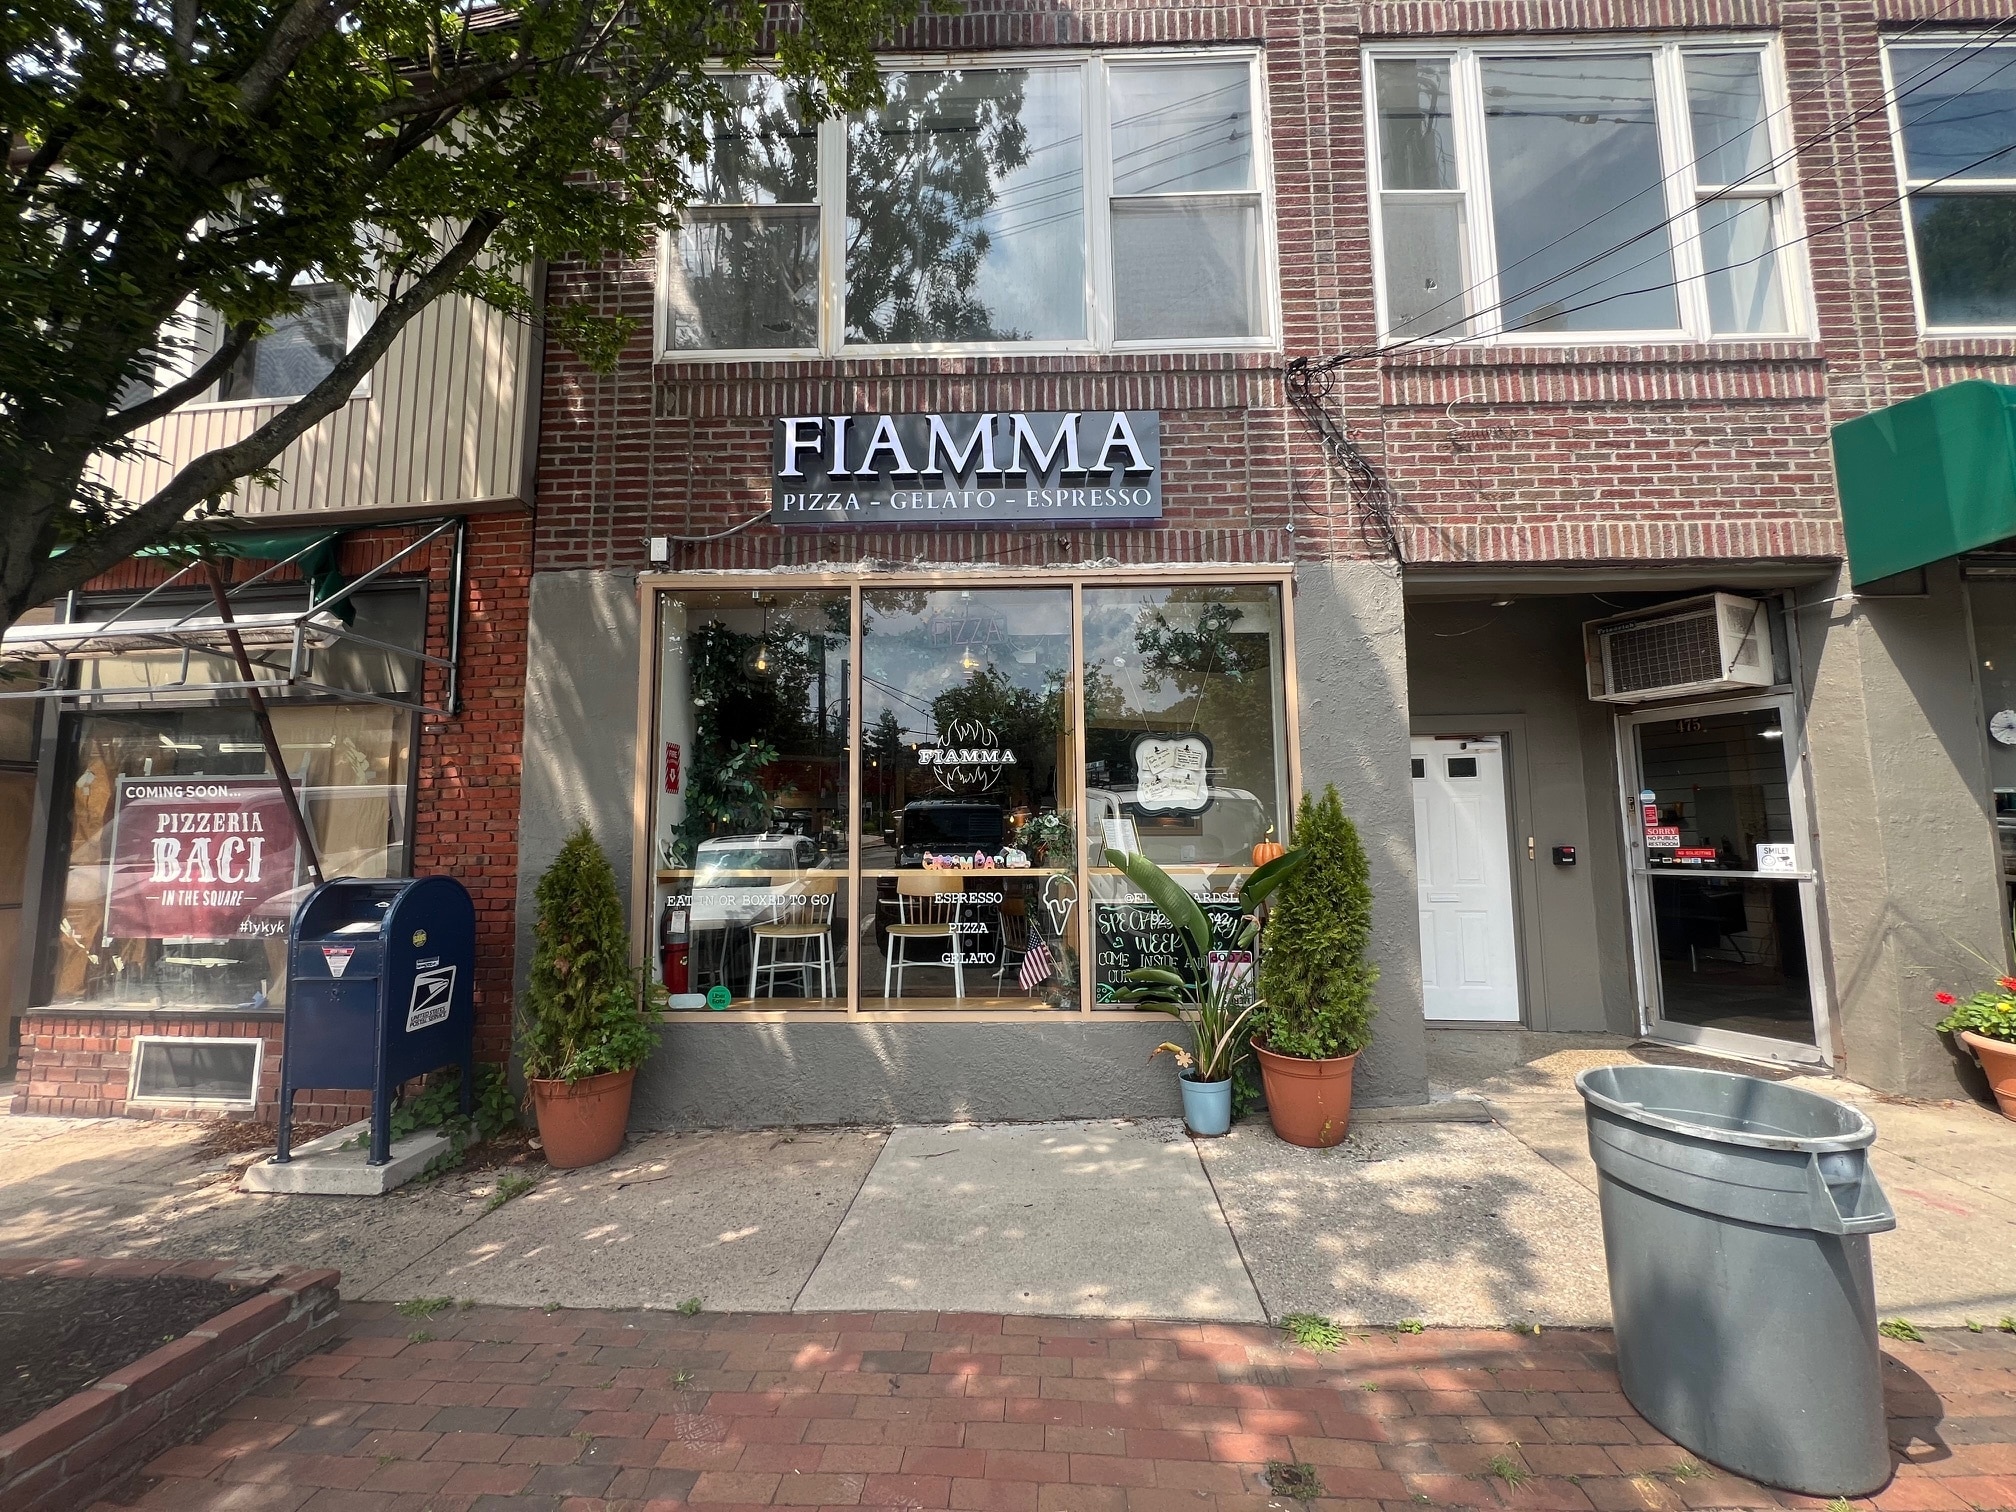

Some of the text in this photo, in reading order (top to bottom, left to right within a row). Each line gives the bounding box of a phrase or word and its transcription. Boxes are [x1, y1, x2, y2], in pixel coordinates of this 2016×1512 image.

[777, 411, 1155, 478] FIAMMA
[783, 488, 1152, 511] PIZZA GELATO ESPRESSO
[933, 616, 1004, 646] PIZZA
[1677, 718, 1701, 732] 475
[918, 749, 1017, 765] FIAMMA
[126, 785, 241, 798] COMING SOON...
[156, 812, 264, 833] PIZZERIA
[149, 836, 265, 883] BACI
[162, 890, 244, 906] IN THE SQUARE
[667, 894, 829, 907] EAT IN OR BOXED TO GO
[934, 892, 1003, 904] ESPRESSO
[948, 922, 989, 934] PIZZA
[942, 952, 996, 964] GELATO
[1098, 950, 1130, 968] COME
